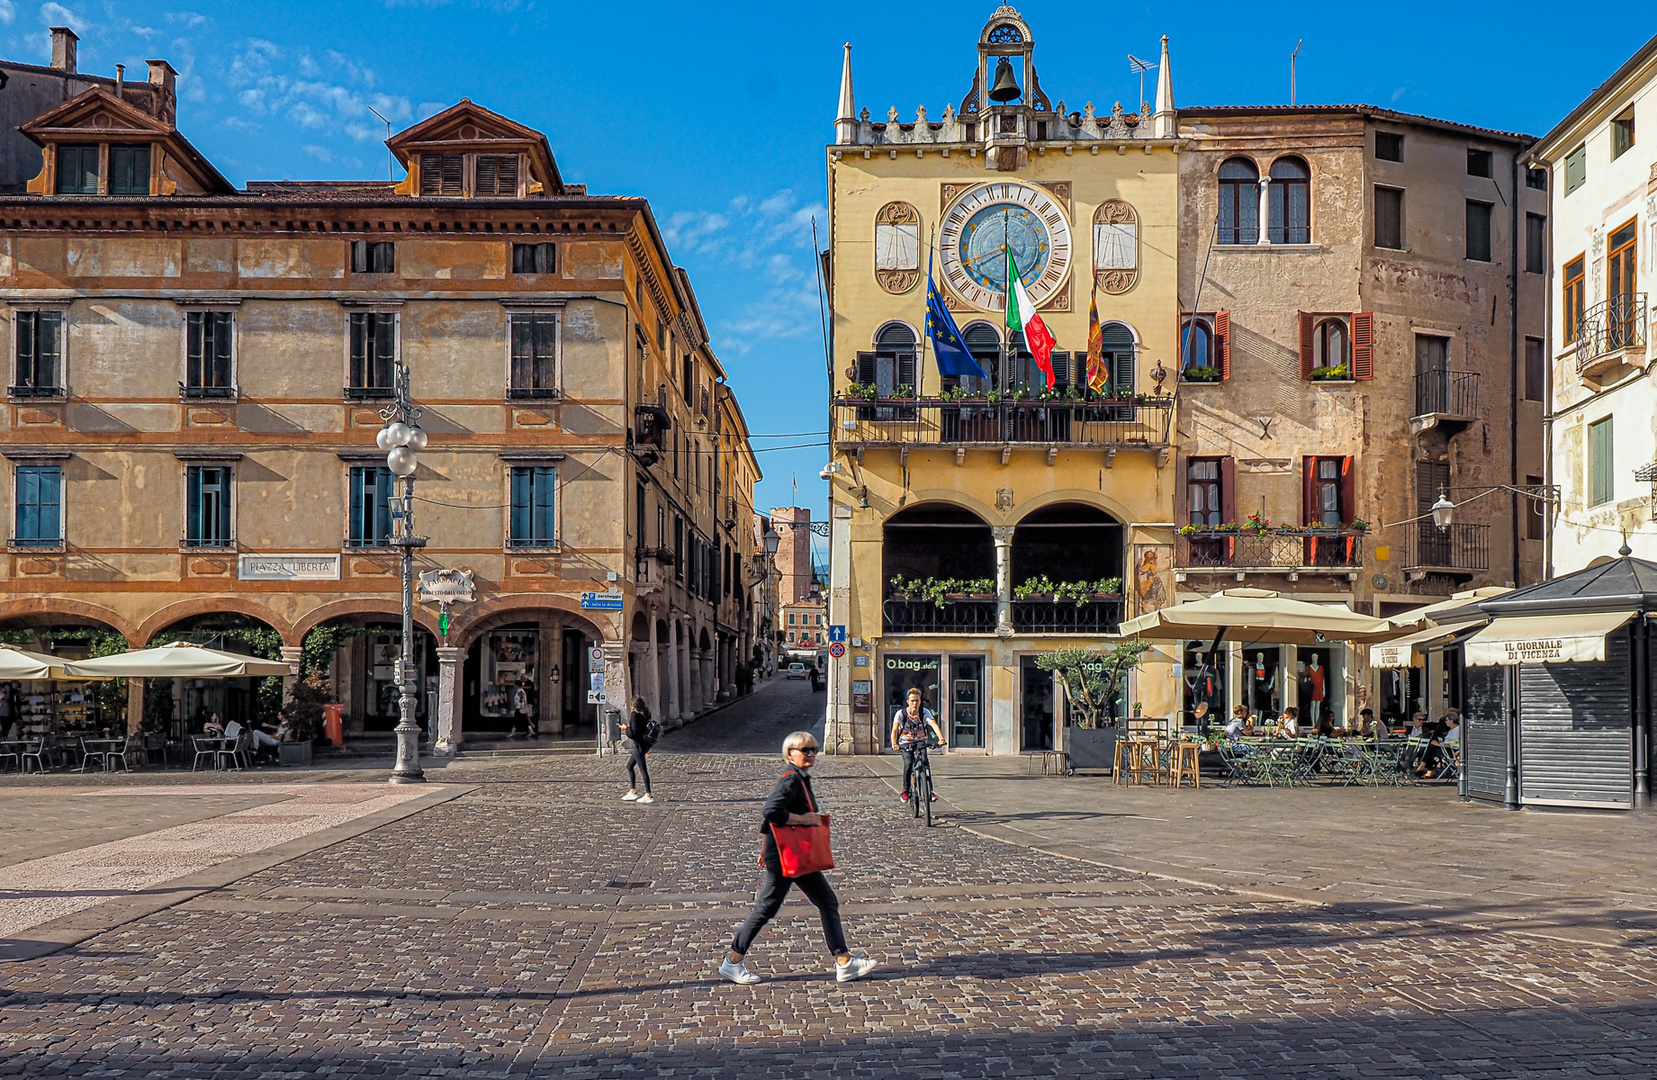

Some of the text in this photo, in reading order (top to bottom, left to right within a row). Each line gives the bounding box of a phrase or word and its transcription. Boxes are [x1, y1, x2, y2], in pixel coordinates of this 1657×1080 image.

[250, 562, 286, 571] PIAZZA
[1505, 640, 1562, 652] IL GIORNALE
[1508, 649, 1560, 660] DI VICENZA
[887, 659, 896, 669] O
